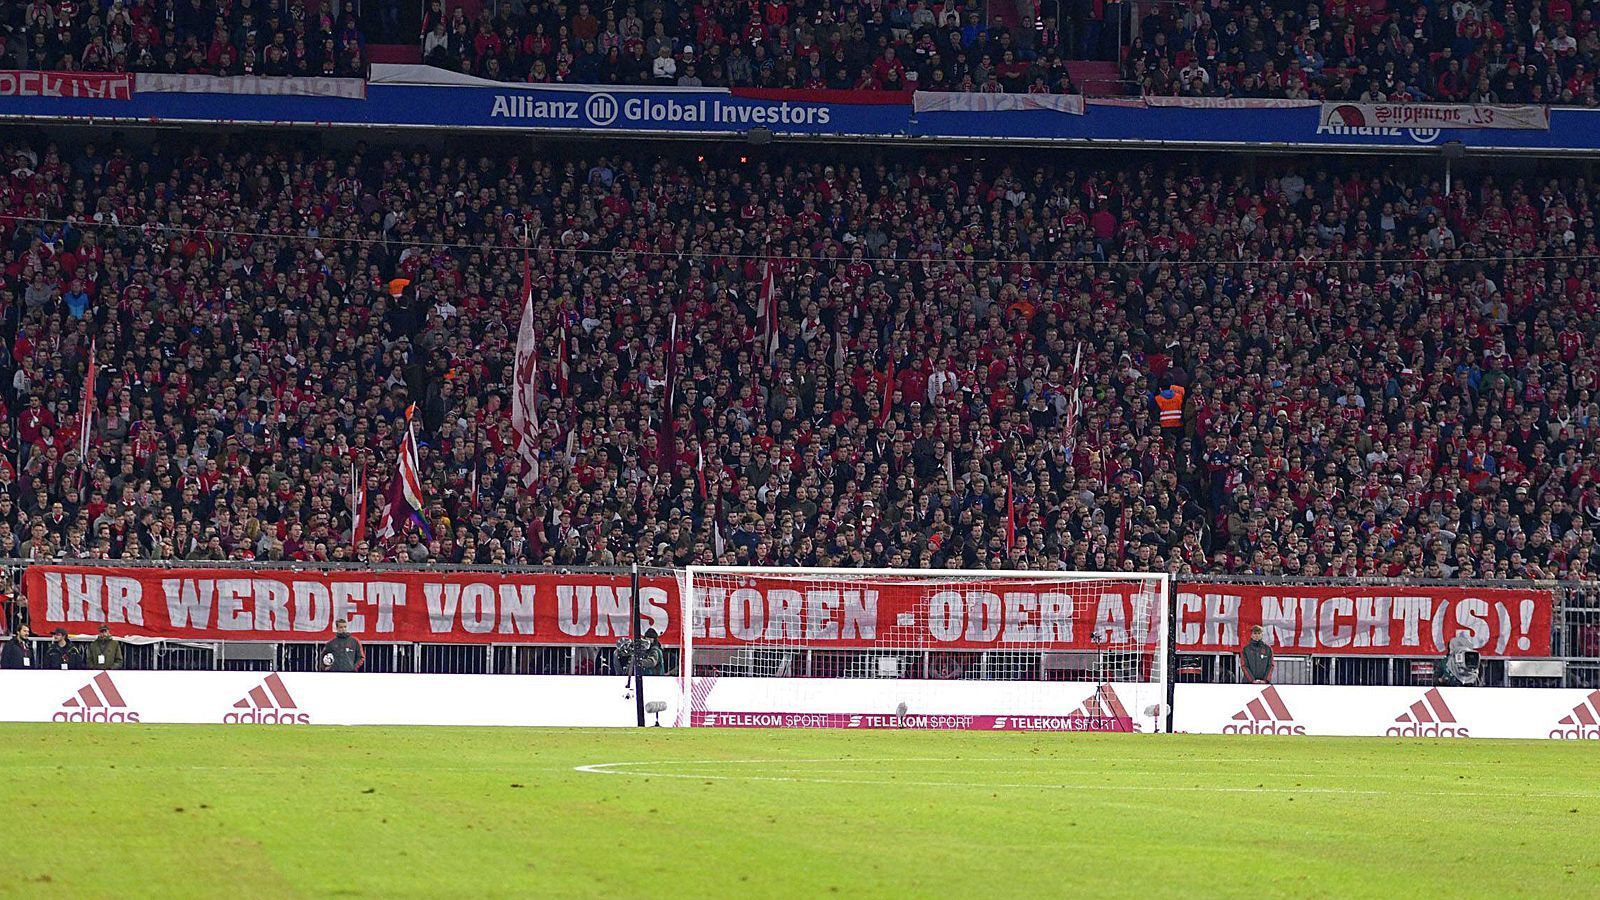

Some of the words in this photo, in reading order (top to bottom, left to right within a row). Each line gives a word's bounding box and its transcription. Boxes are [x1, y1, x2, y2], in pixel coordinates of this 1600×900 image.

[491, 95, 578, 119] Allianz
[624, 98, 706, 122] Global
[714, 100, 830, 124] Investors
[45, 571, 144, 627] IHR
[162, 578, 407, 633] WERDET
[423, 582, 536, 635] VON
[556, 585, 670, 637] UNS
[691, 579, 879, 641] HÖREN
[927, 591, 1074, 643] ODER
[52, 706, 140, 723] adidas
[223, 708, 310, 724] adidas
[720, 714, 782, 727] TELEKOM
[785, 714, 828, 727] SPORT
[865, 715, 928, 728] TELEKOM
[930, 716, 973, 728] SPORT
[1010, 717, 1072, 729] TELEKOM
[1222, 720, 1306, 735] adidas
[1386, 722, 1470, 738] adidas
